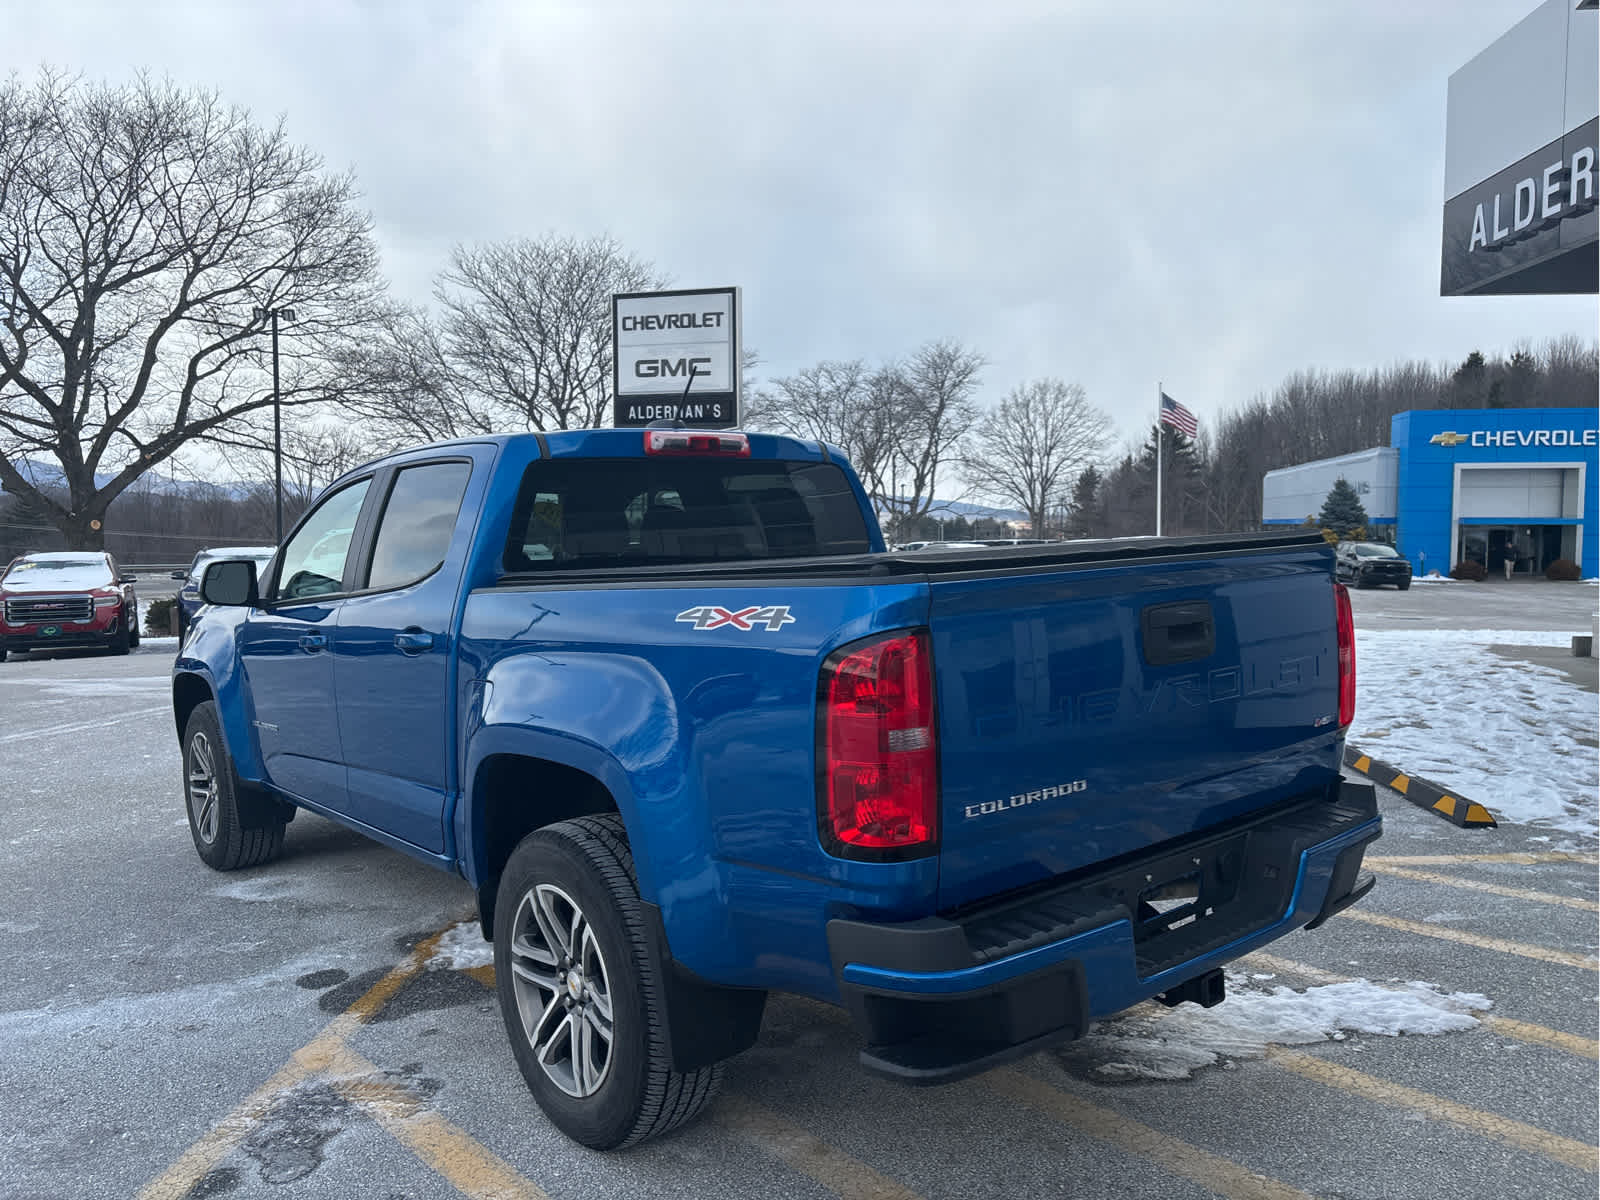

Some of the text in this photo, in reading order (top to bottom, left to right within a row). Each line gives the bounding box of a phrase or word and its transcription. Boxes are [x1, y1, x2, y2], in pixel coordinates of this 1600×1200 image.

[1469, 146, 1595, 253] ALDER
[622, 312, 724, 331] CHEVROLET
[635, 357, 711, 377] GMC
[1471, 429, 1599, 447] CHEVROLE
[965, 780, 1088, 818] COLORADO
